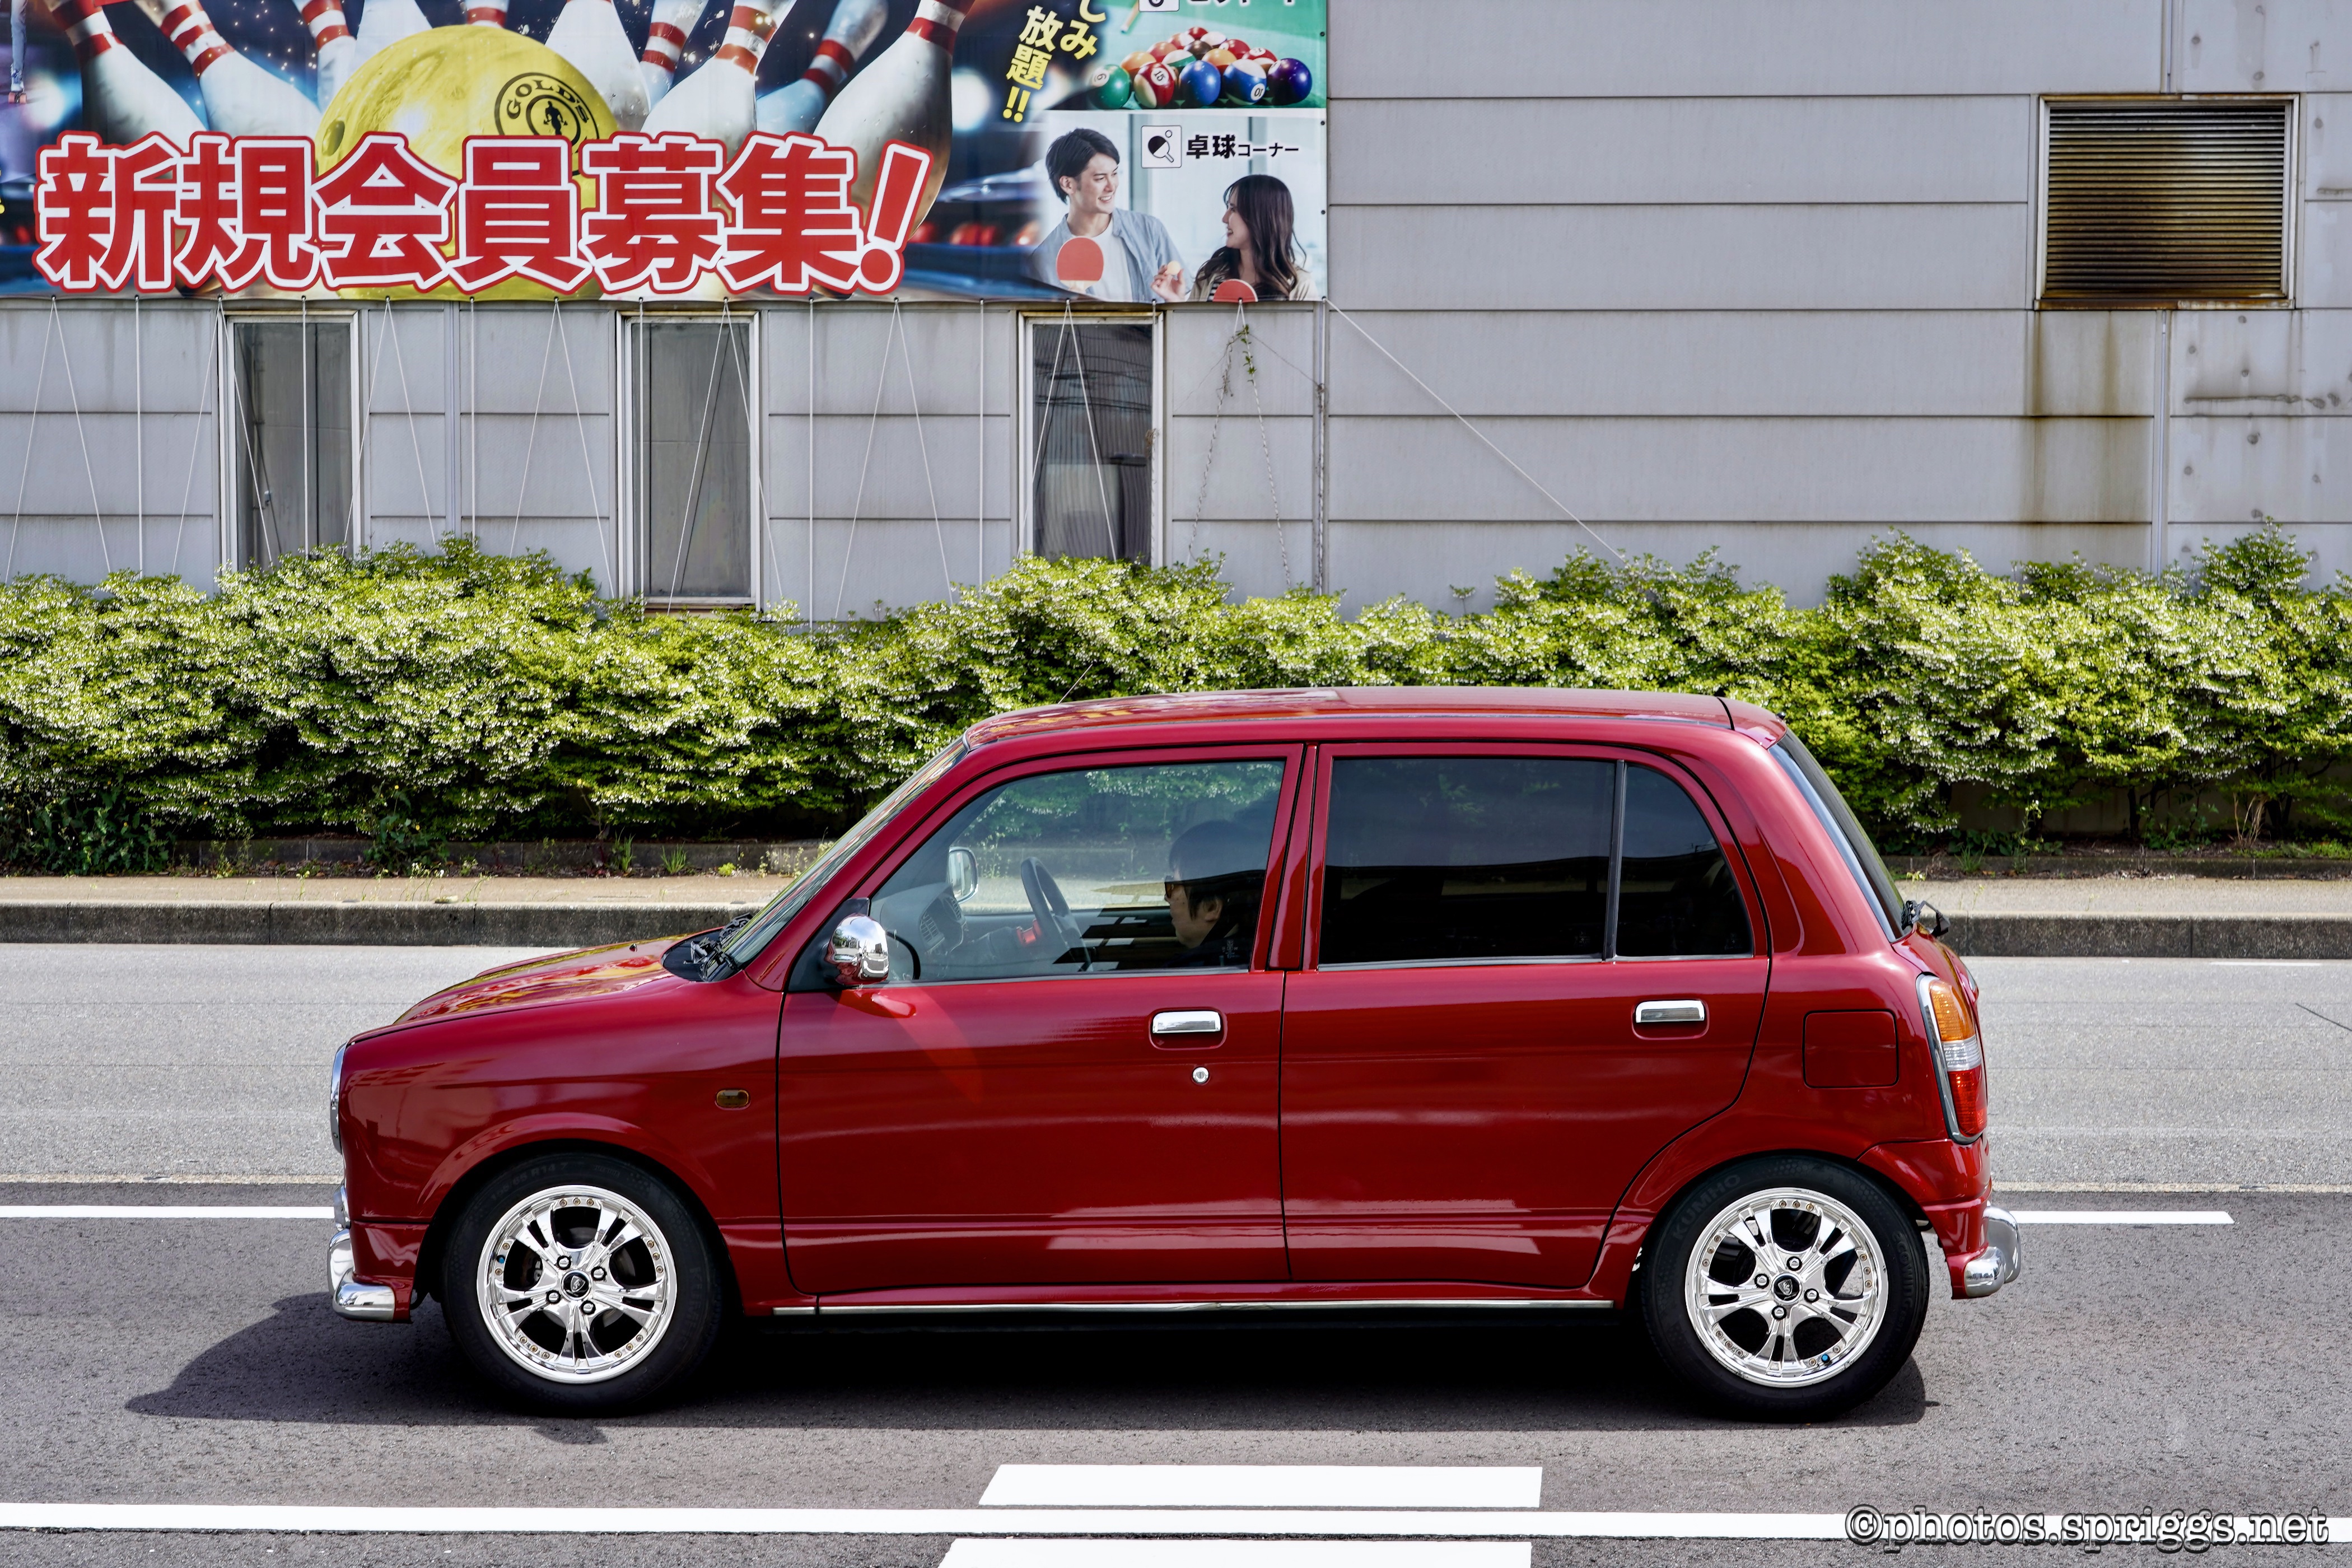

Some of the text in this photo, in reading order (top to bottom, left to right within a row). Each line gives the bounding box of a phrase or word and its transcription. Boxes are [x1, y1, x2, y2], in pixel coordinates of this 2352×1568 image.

[506, 80, 589, 123] GOLD'S
[1186, 134, 1299, 159] 卓球コーナー
[32, 130, 934, 295] 新規会員募集!
[1672, 1173, 1741, 1240] KUMHO
